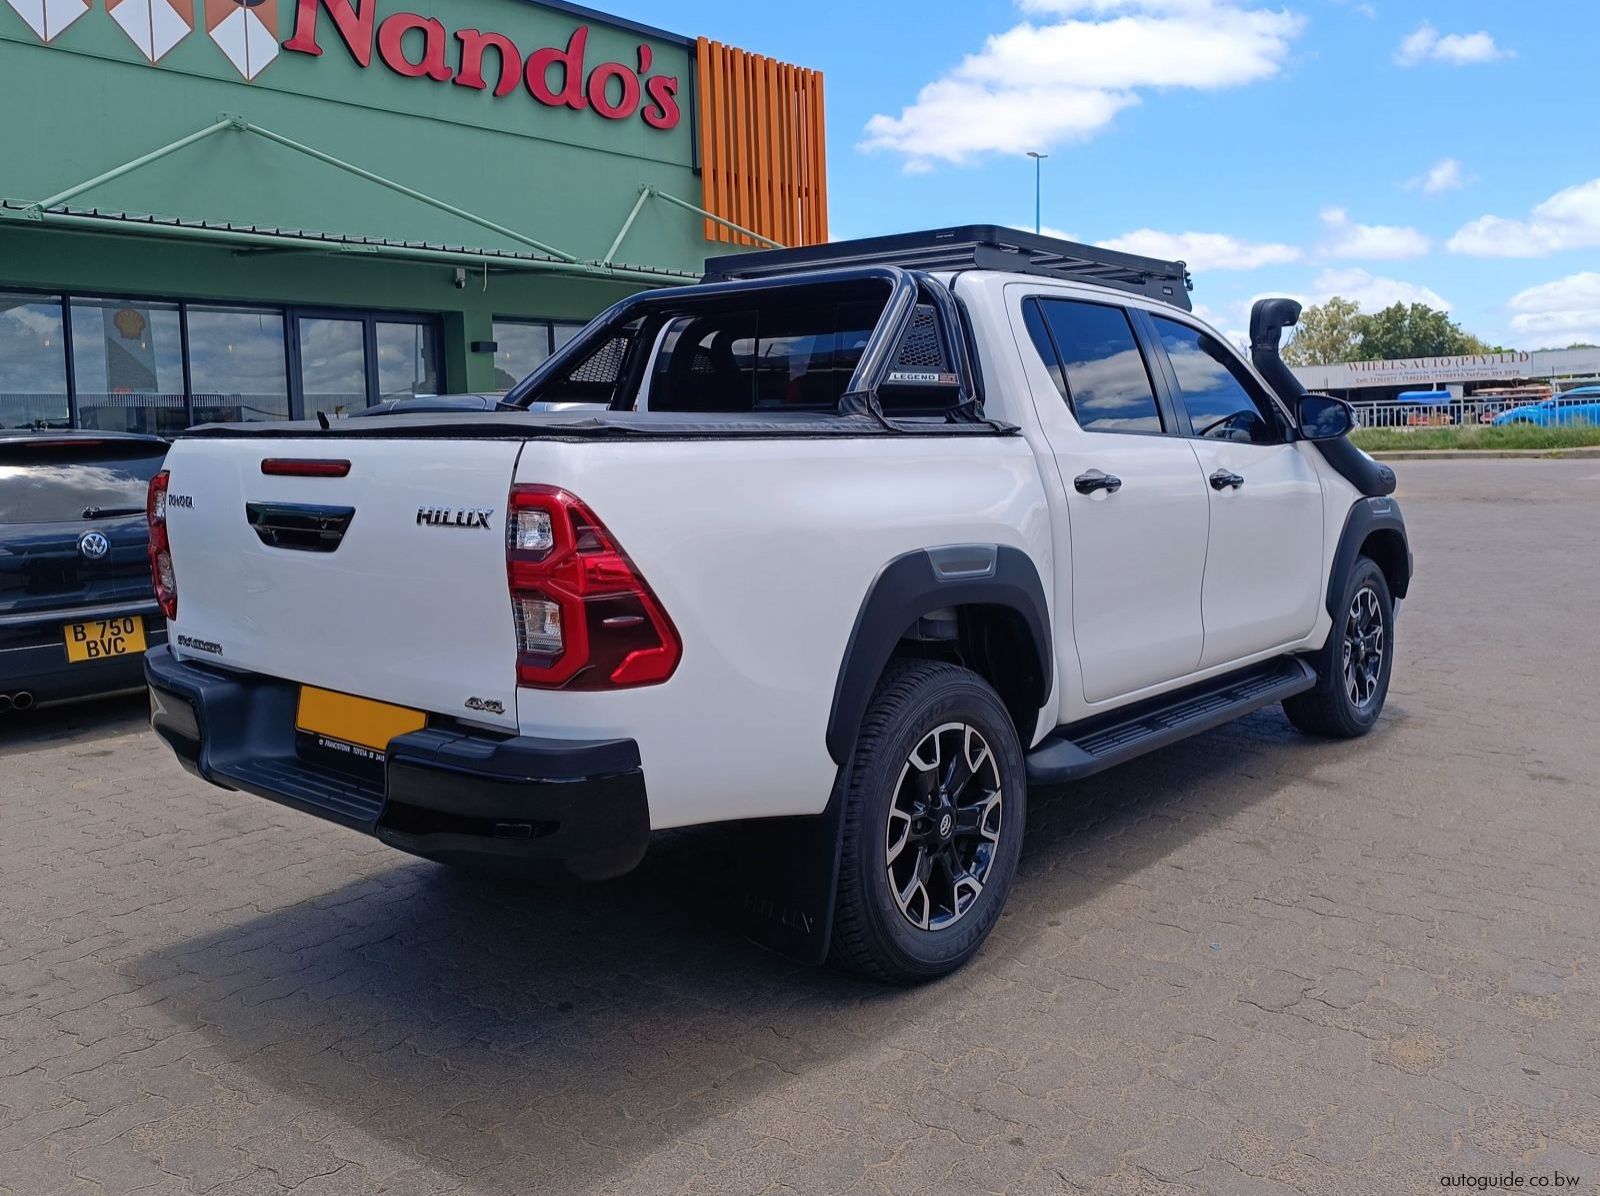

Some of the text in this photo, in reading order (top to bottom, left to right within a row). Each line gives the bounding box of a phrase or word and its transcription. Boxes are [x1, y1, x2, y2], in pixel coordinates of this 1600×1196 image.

[281, 0, 682, 130] Nando's
[1348, 360, 1407, 372] WHEELS
[1411, 357, 1451, 369] AUTO
[1455, 354, 1495, 368] (PTY)
[1500, 350, 1529, 363] LTD
[168, 494, 195, 509] TOYOTA
[416, 506, 494, 530] HILUX
[72, 617, 135, 642] B 750
[86, 636, 127, 658] BVC
